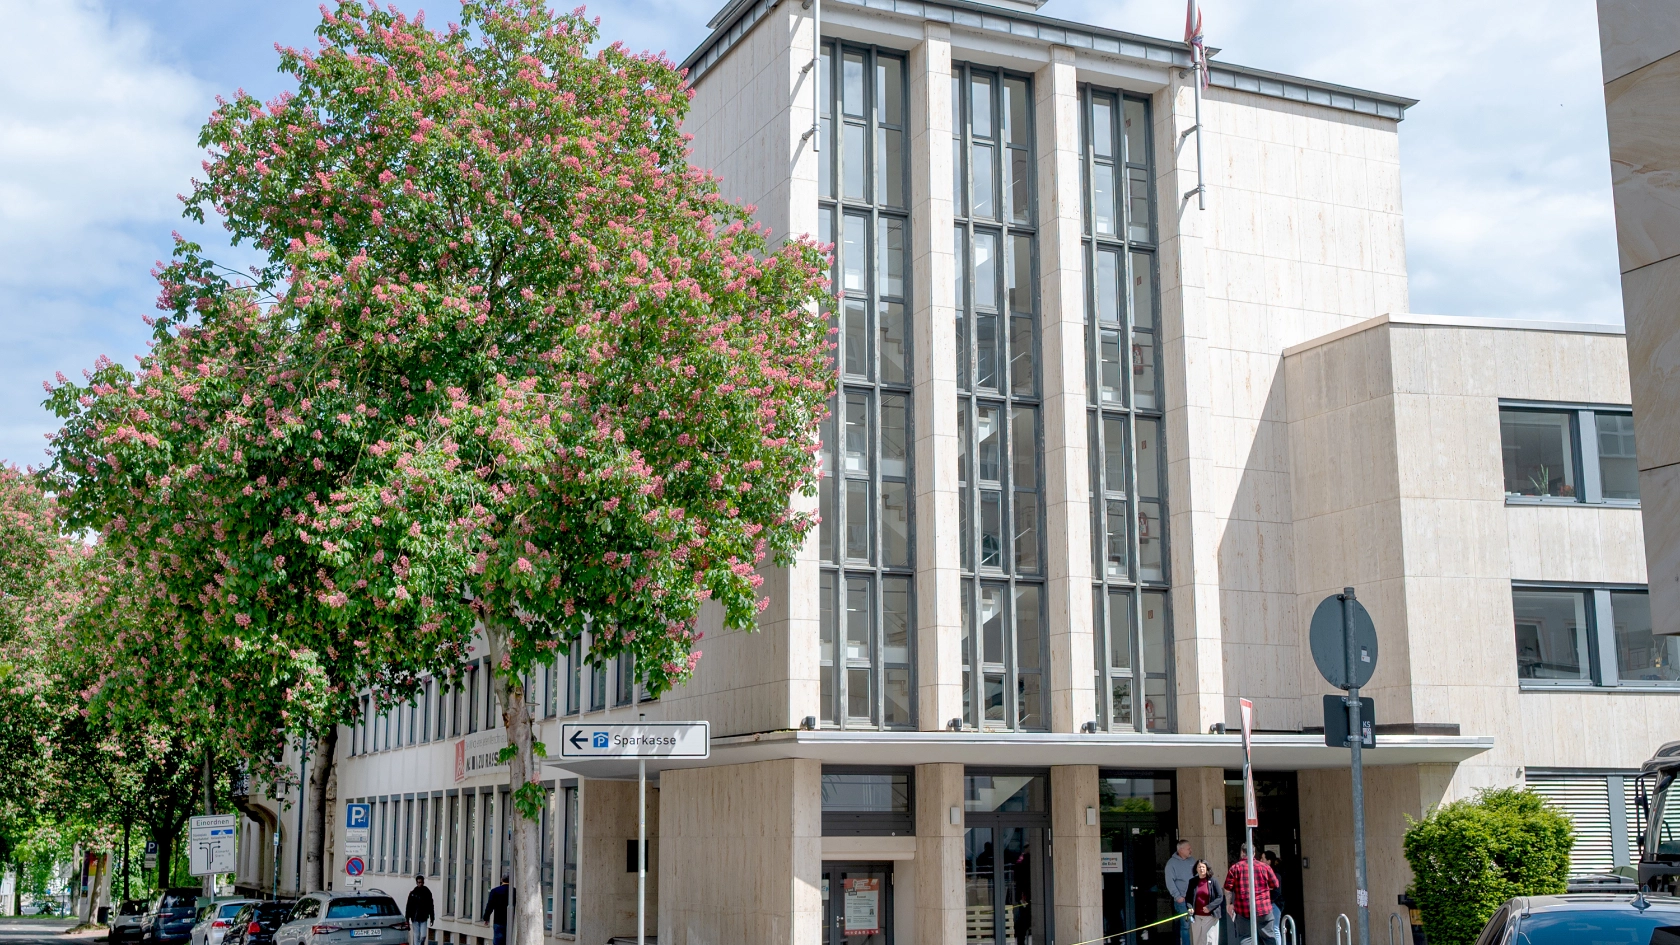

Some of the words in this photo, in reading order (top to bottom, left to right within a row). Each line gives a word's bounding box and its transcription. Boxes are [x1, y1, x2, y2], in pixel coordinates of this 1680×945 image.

[597, 738, 605, 747] P
[614, 734, 676, 748] Sparkasse
[351, 806, 364, 825] P
[196, 819, 230, 827] Einordnen
[148, 842, 156, 852] P
